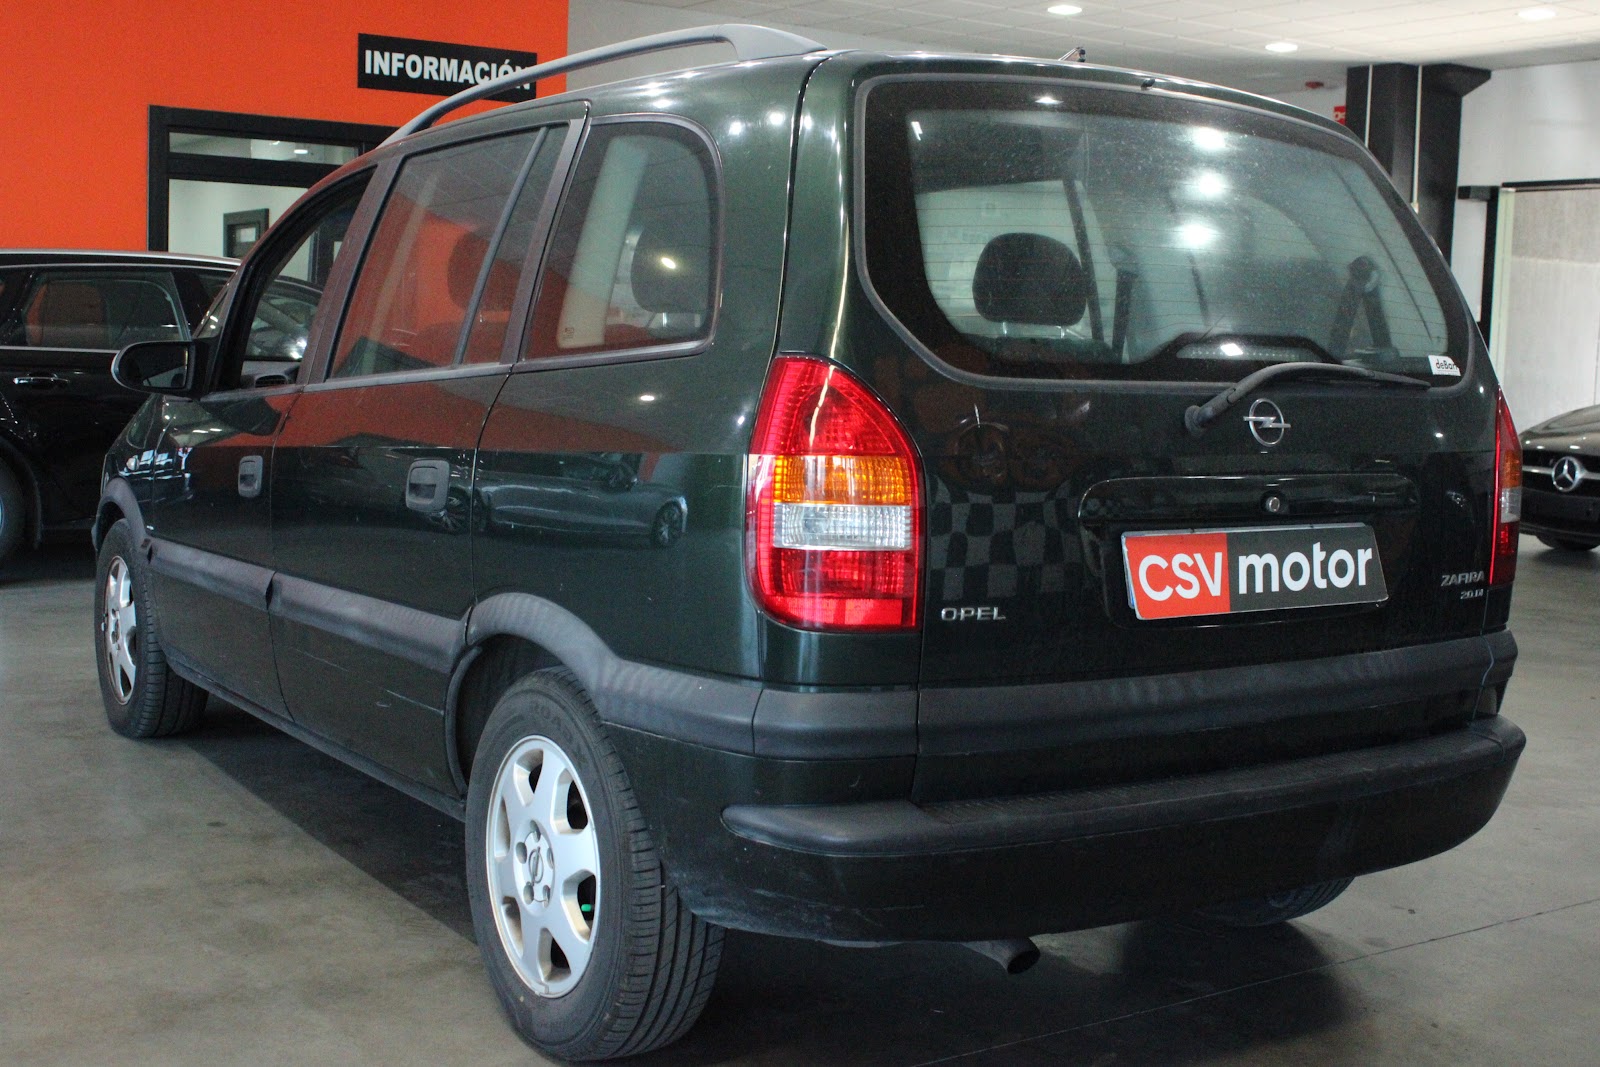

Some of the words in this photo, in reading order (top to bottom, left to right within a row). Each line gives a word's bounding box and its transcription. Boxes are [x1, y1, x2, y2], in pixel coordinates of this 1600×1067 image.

[1138, 552, 1223, 602] CSV
[1238, 541, 1373, 595] motor
[1440, 570, 1485, 587] ZAFIRA
[941, 606, 1006, 621] OPEL
